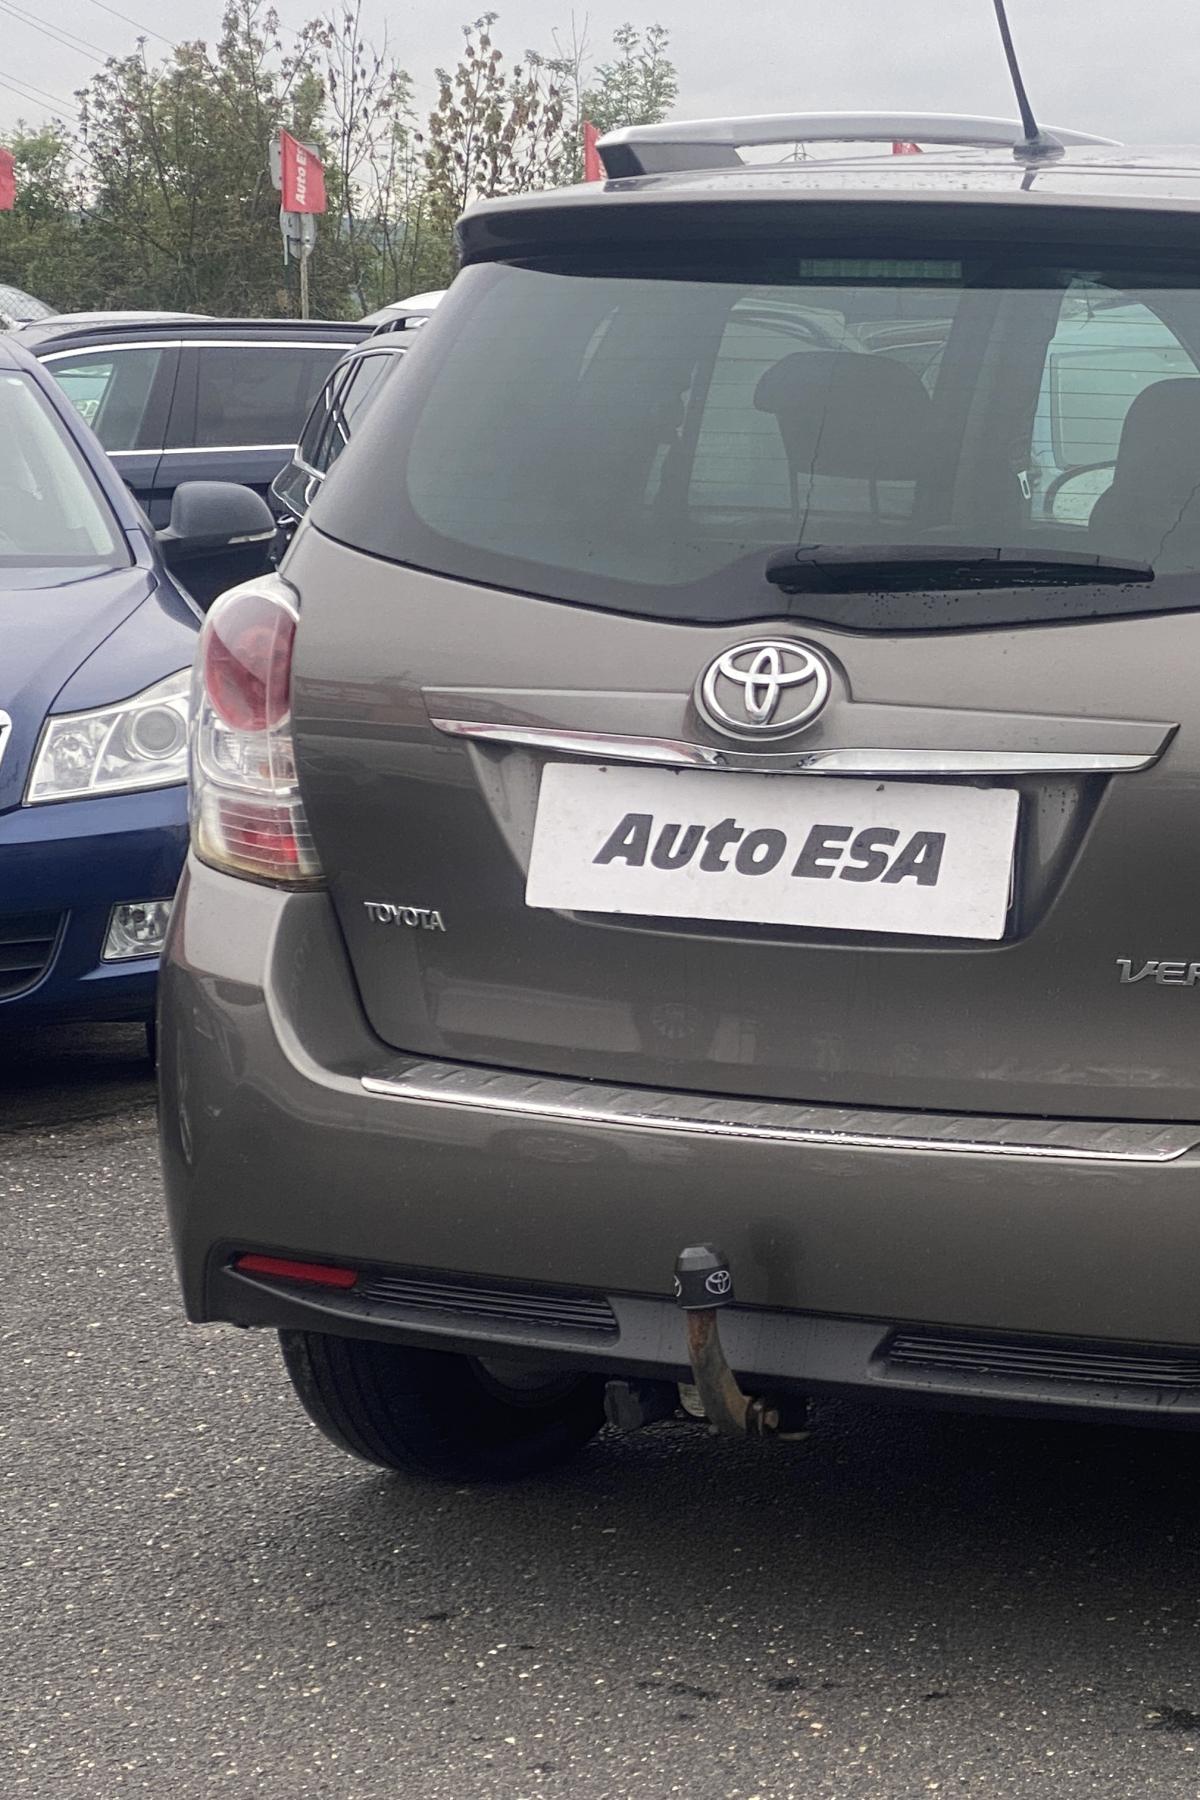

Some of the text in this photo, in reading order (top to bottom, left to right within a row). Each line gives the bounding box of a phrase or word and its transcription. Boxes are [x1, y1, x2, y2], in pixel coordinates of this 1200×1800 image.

[295, 167, 307, 205] Auto
[593, 813, 946, 887] Auto ESA
[363, 901, 446, 932] TOYOTA
